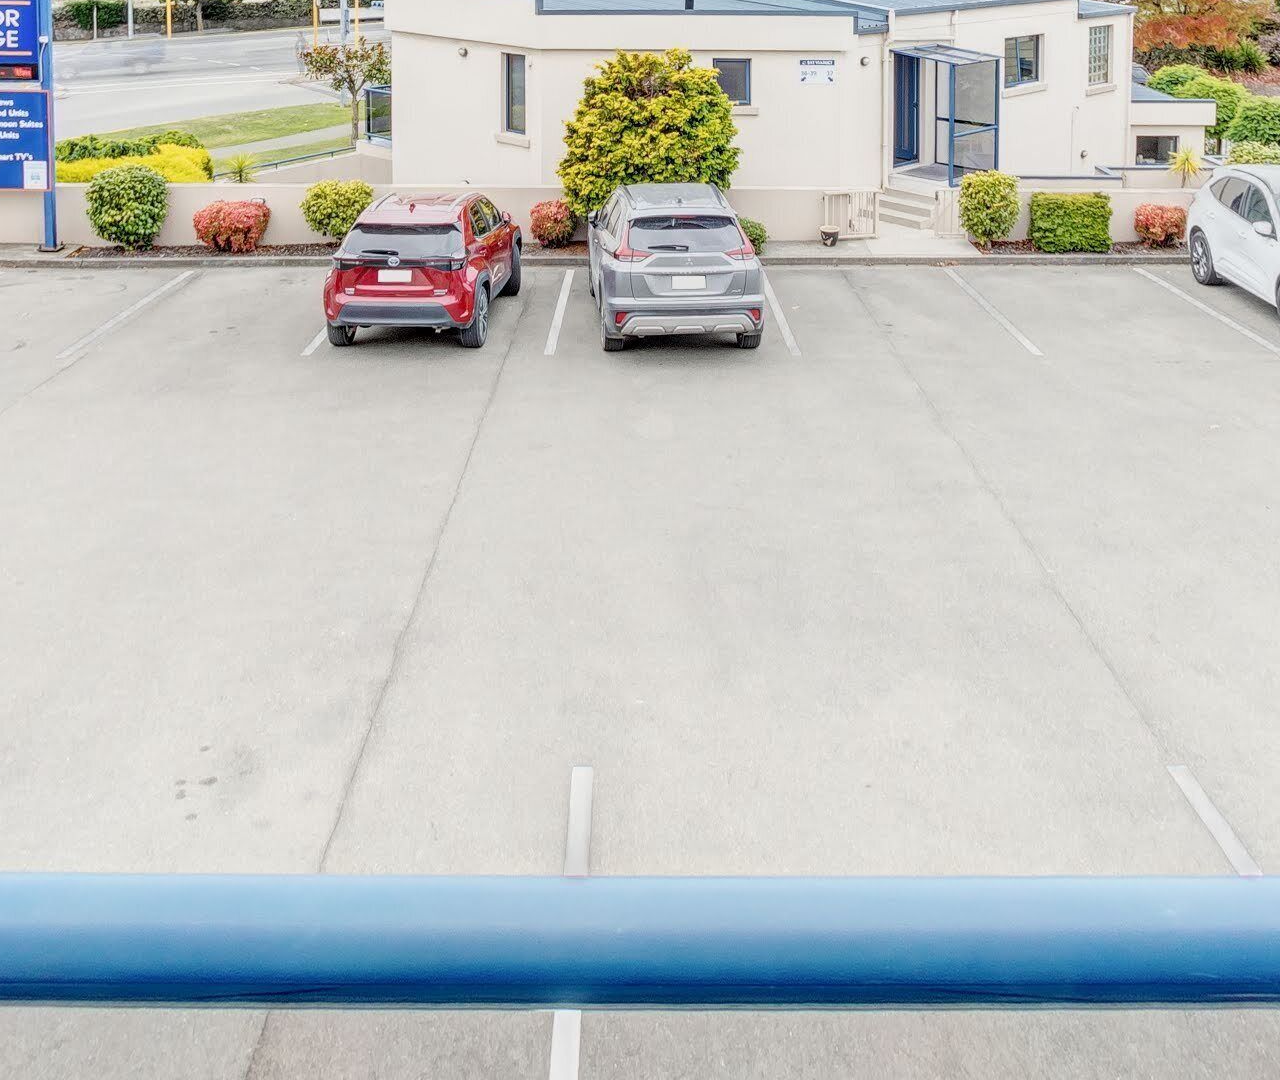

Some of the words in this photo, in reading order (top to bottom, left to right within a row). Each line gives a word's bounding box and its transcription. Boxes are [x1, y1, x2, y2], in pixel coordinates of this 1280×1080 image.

[8, 109, 29, 117] Units
[19, 120, 43, 128] Suites
[0, 131, 20, 139] Units
